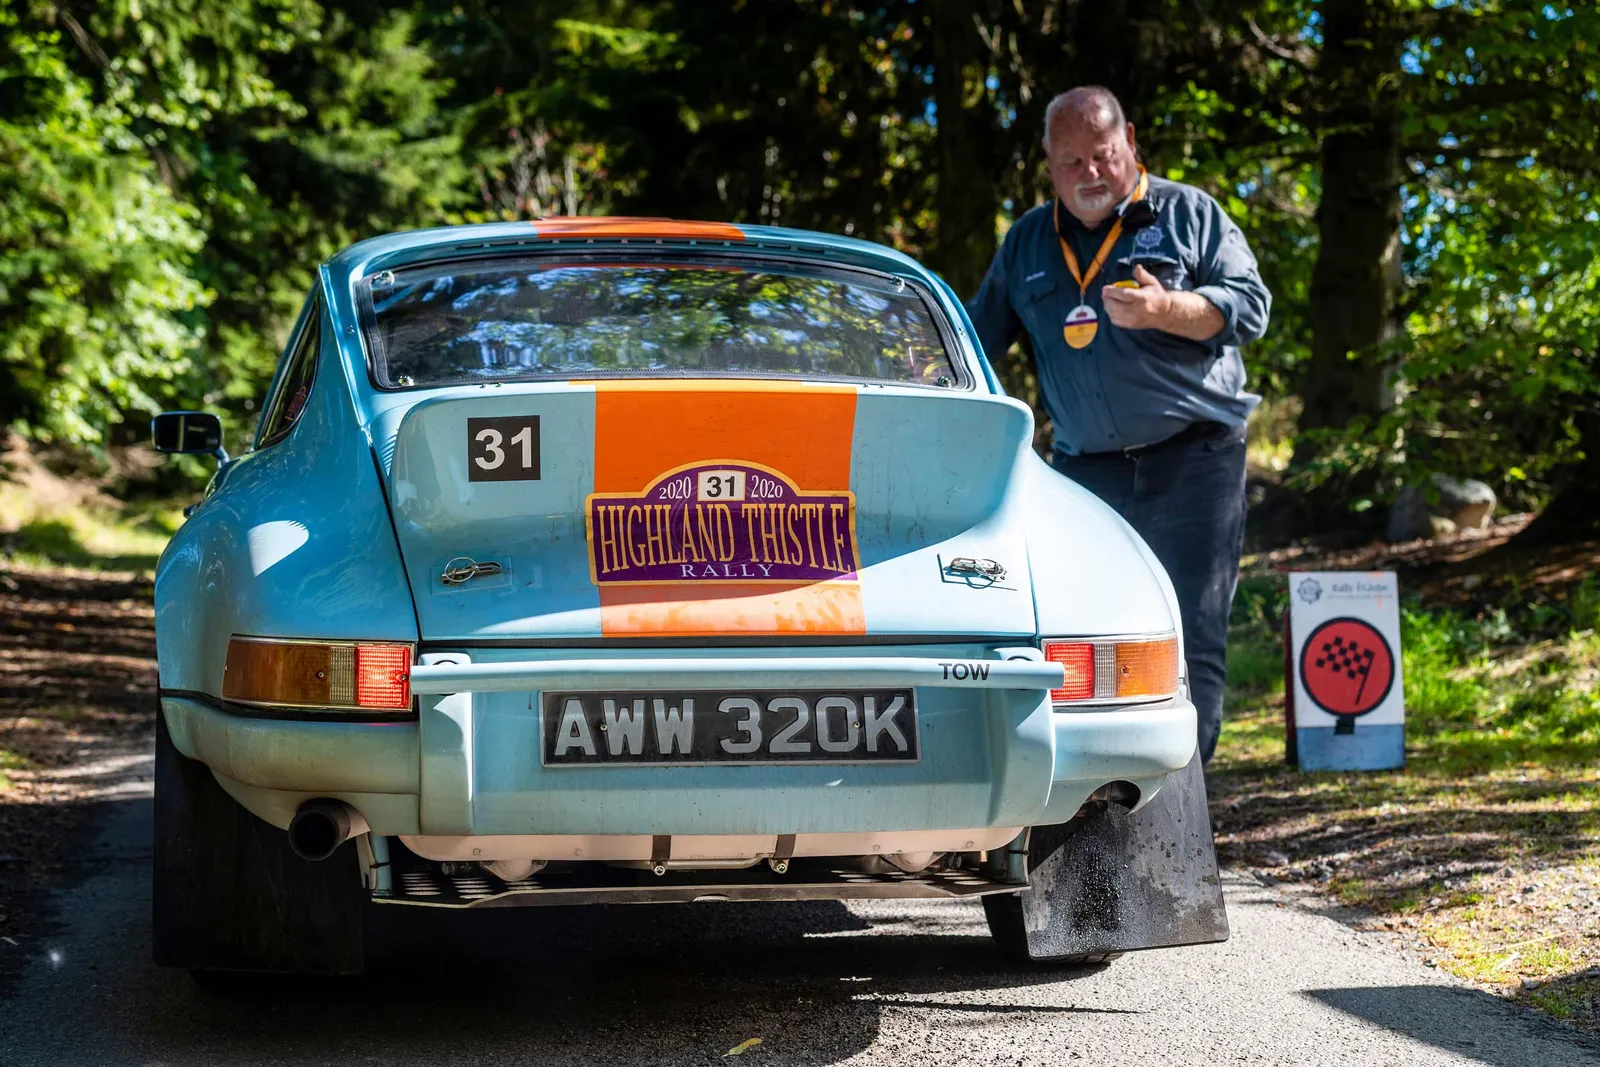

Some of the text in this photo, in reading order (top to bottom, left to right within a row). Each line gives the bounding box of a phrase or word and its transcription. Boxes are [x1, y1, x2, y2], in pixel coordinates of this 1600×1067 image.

[474, 427, 532, 470] 31
[659, 474, 784, 500] 2020 31 2020
[597, 503, 851, 574] HIGHLAND THISTLE
[679, 563, 774, 578] RALLY
[938, 663, 990, 681] TOW
[554, 697, 908, 756] AWW 320K
